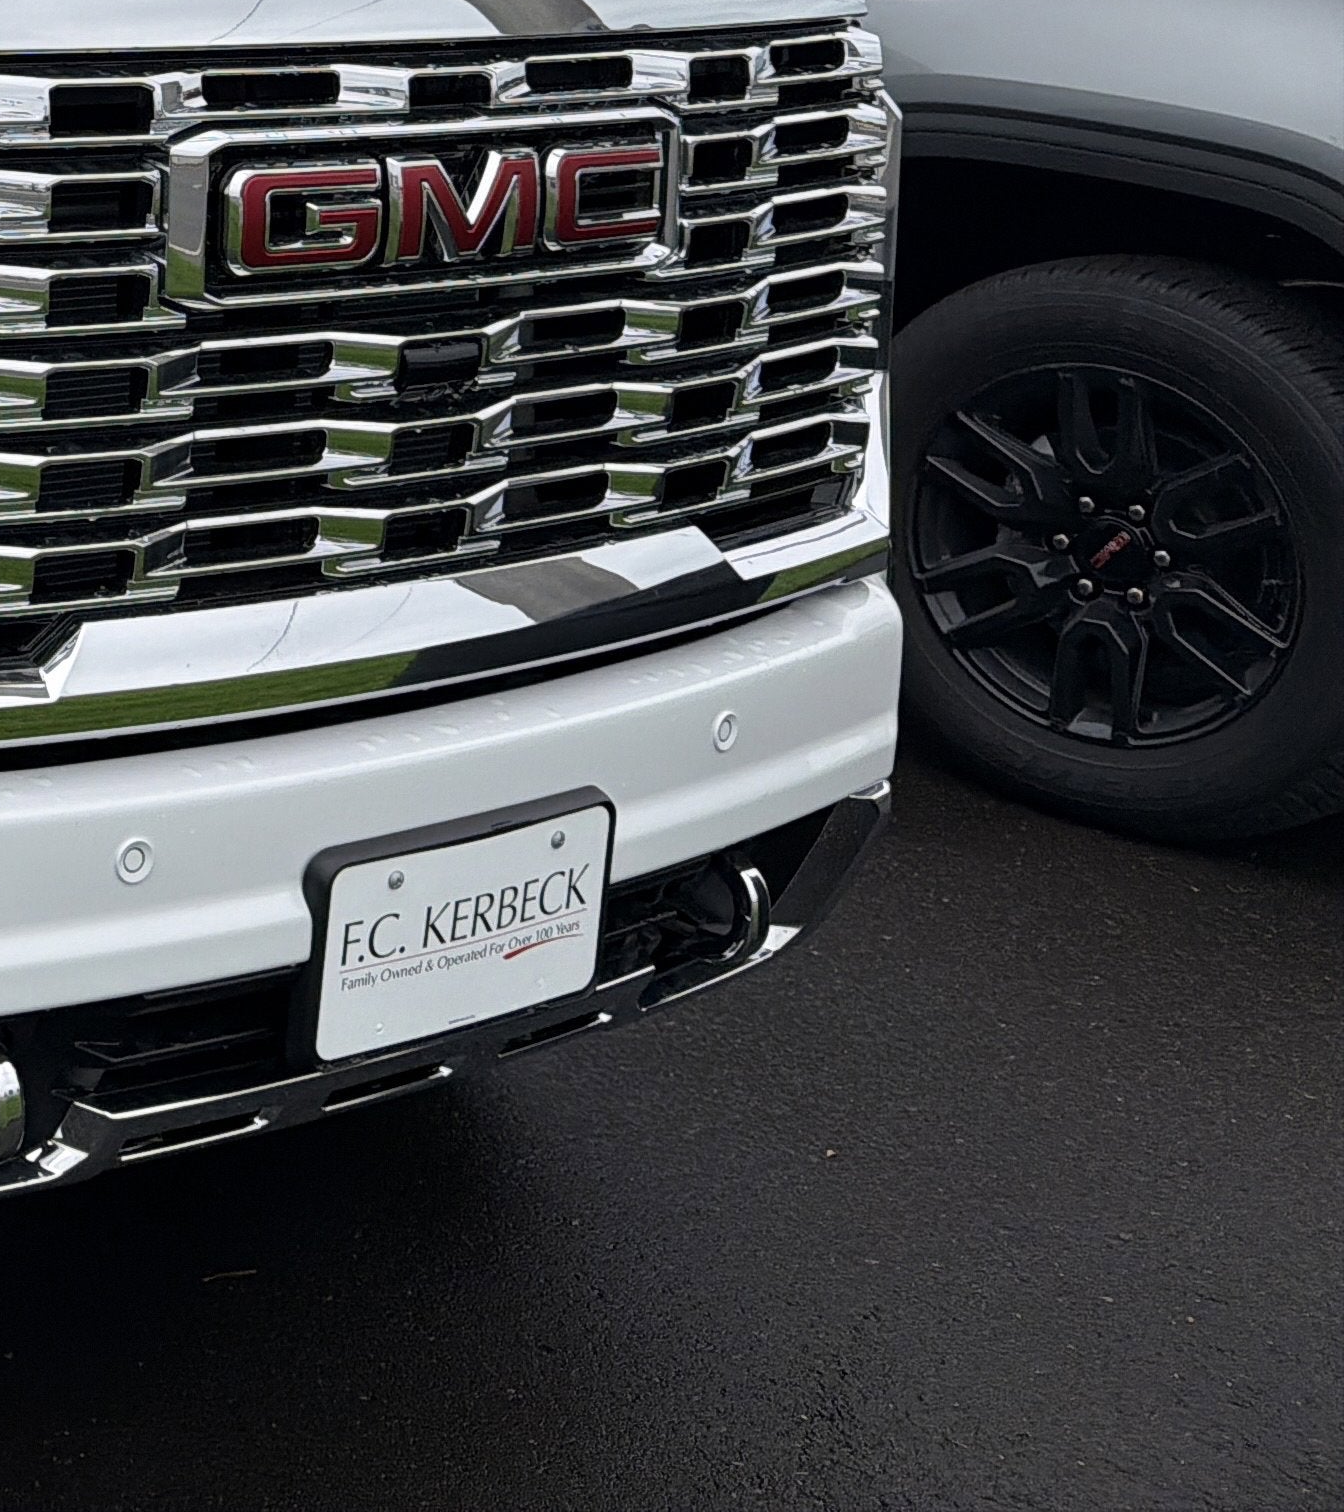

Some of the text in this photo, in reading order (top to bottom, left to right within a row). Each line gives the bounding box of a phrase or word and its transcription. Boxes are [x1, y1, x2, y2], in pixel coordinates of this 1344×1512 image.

[224, 145, 664, 278] GMC
[340, 919, 581, 992] Family Owned & Operated For Over 100 Years
[341, 863, 590, 967] F.C. KERBECK
